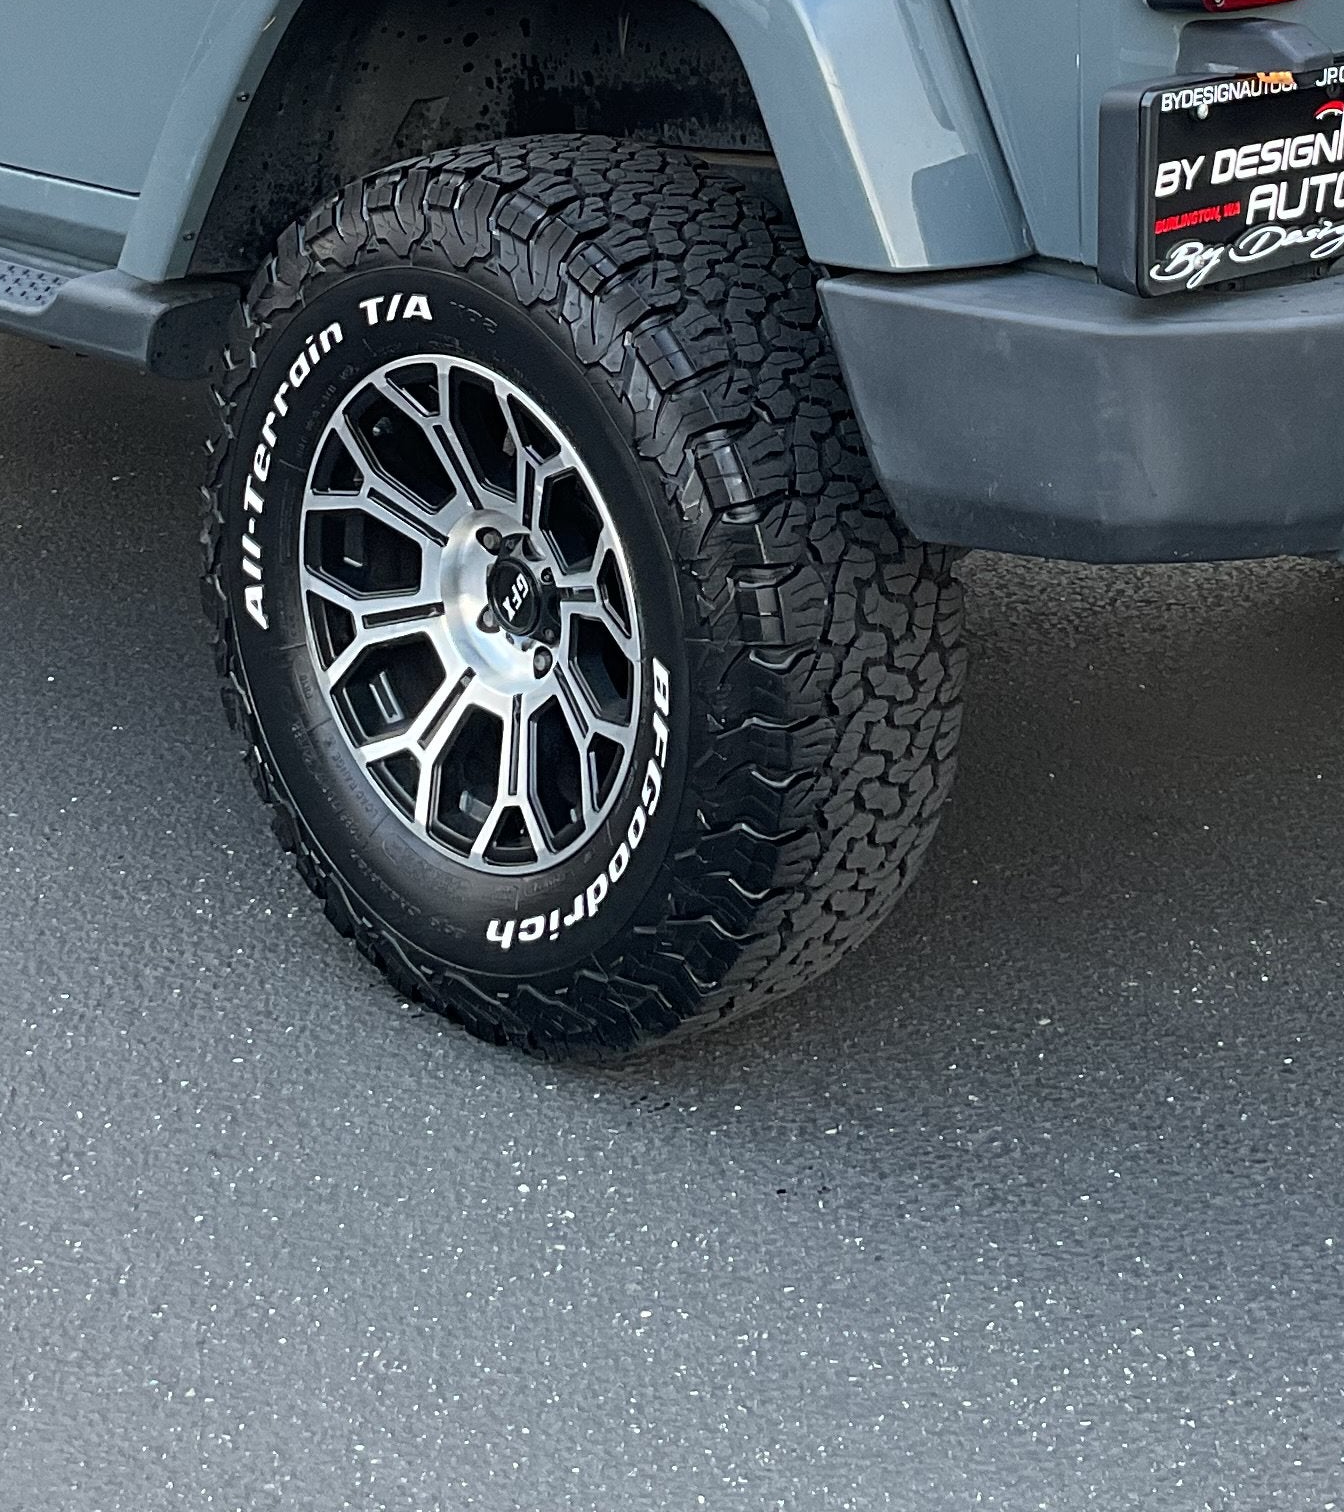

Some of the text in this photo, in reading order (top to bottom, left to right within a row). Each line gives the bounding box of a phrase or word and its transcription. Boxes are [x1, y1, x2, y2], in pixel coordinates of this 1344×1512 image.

[1155, 129, 1343, 198] BY DESIGN
[1149, 241, 1225, 289] By
[242, 321, 344, 630] All-Terrain
[359, 292, 433, 326] T/A
[502, 572, 529, 622] GFX
[486, 657, 670, 949] BFGoodrich
